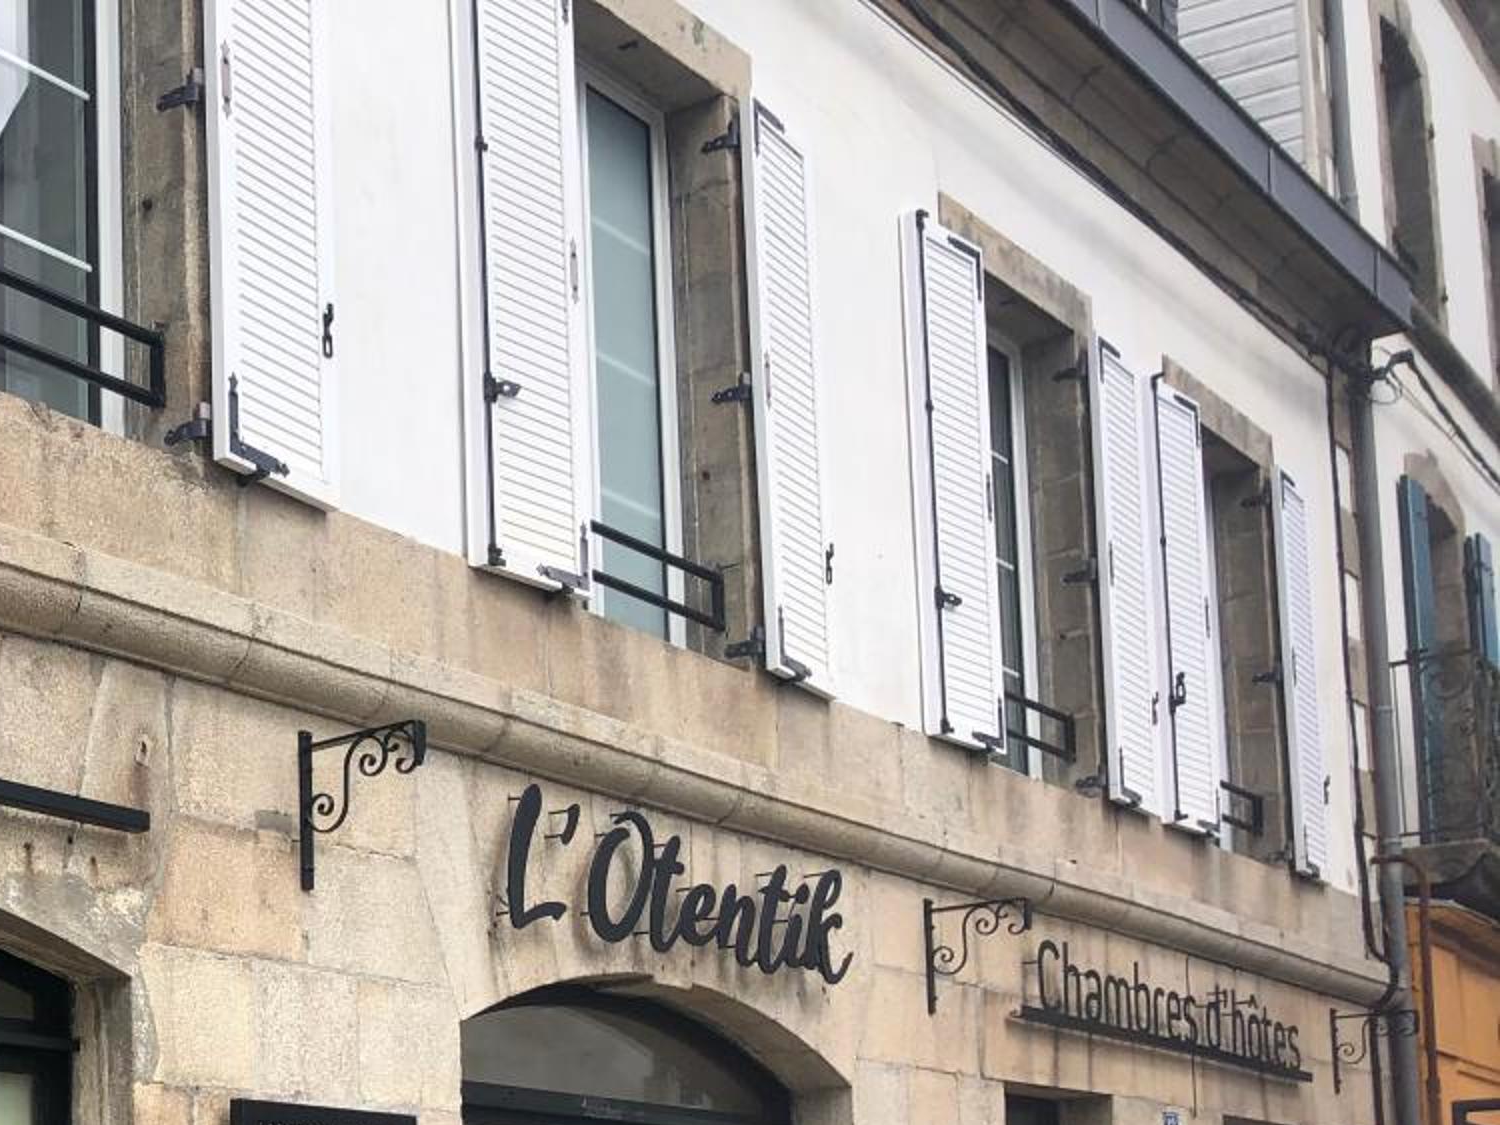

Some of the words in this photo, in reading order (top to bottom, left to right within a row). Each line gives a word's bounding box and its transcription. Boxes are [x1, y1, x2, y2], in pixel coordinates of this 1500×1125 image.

[506, 784, 854, 984] L'Otentik
[1037, 940, 1199, 1047] Chambres
[1206, 984, 1301, 1070] d'hôtes
